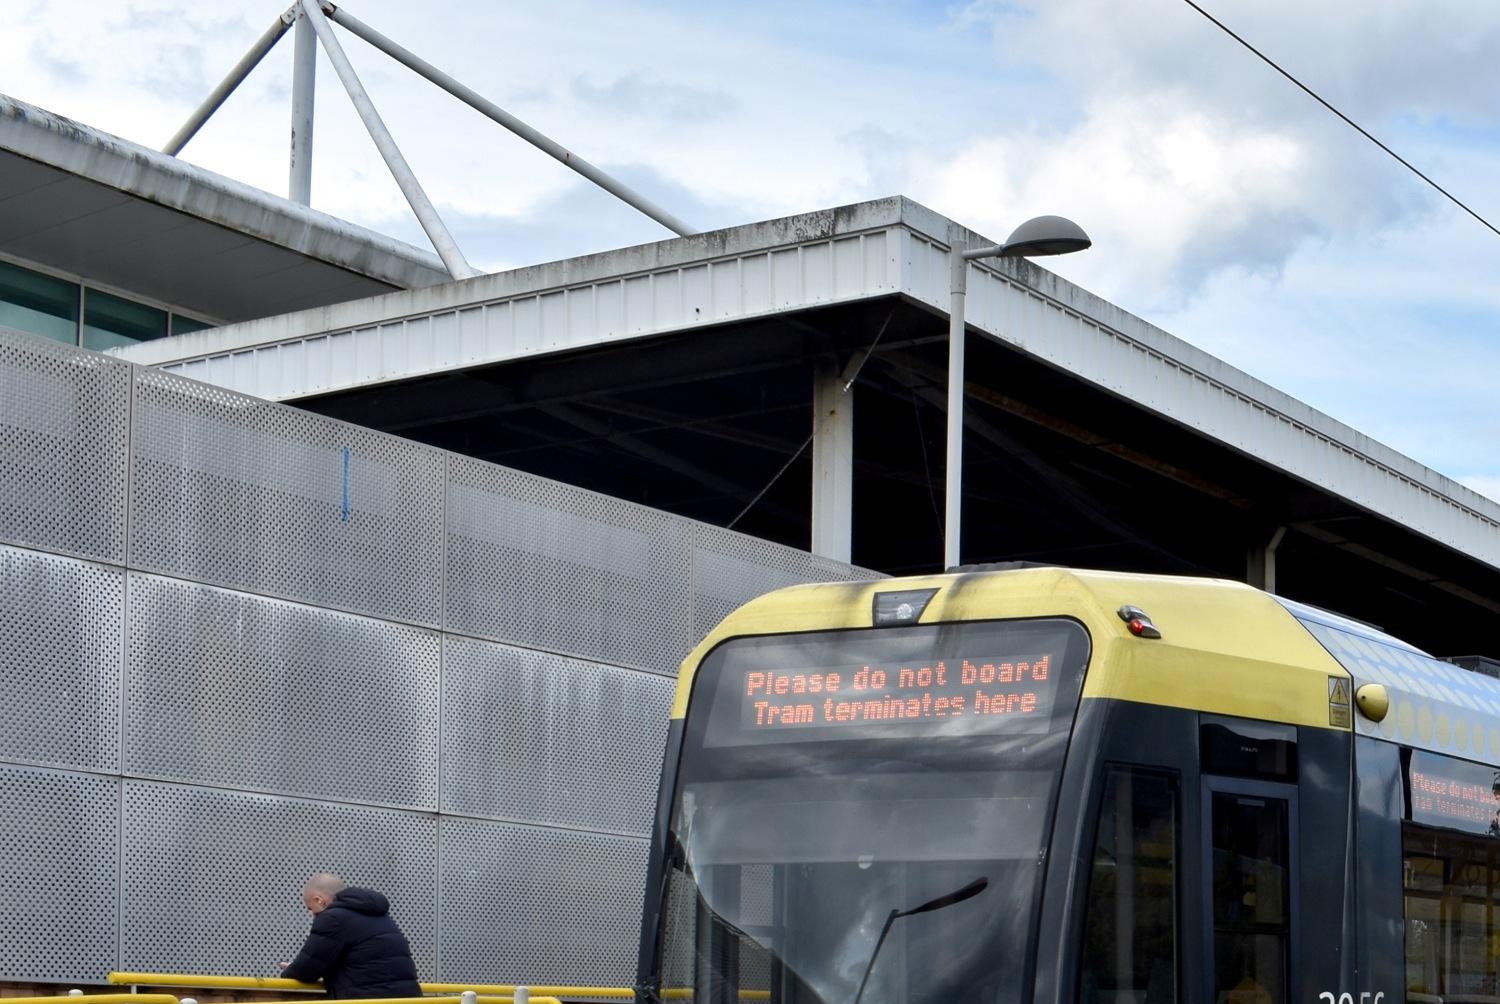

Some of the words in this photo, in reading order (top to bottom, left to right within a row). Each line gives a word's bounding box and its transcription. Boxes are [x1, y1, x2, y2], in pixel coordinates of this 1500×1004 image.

[747, 671, 840, 696] Please
[853, 666, 887, 690] do
[899, 661, 947, 688] not
[961, 656, 1049, 685] board
[754, 701, 814, 725] Tram
[823, 692, 965, 722] terminates
[974, 690, 1036, 715] here
